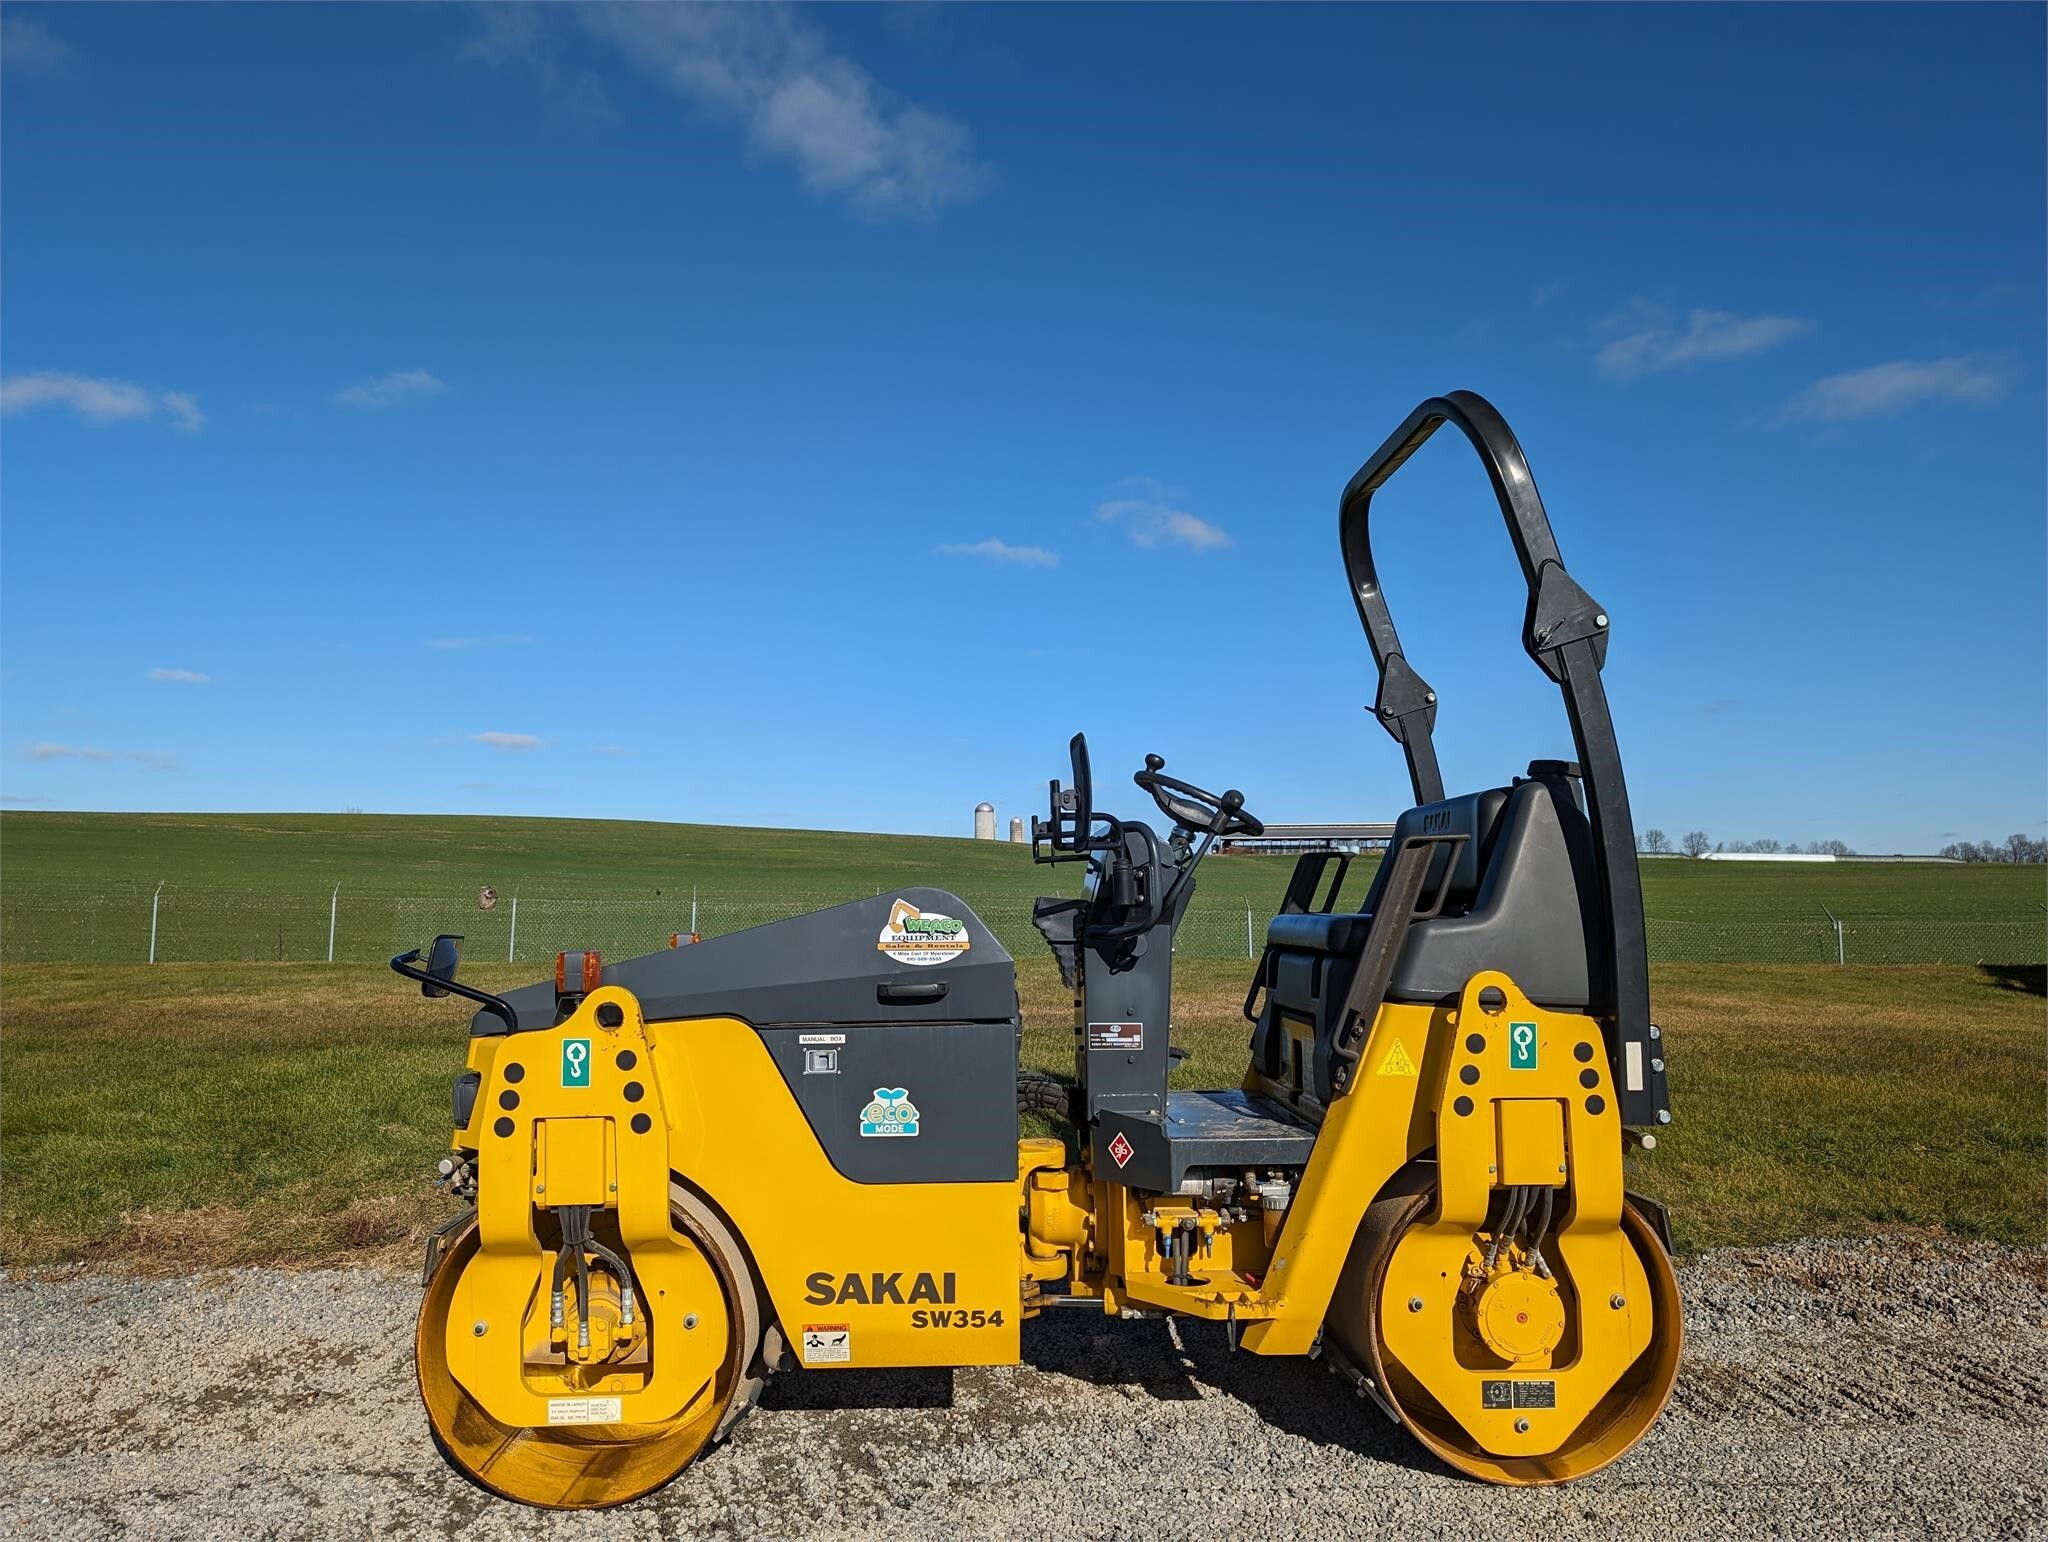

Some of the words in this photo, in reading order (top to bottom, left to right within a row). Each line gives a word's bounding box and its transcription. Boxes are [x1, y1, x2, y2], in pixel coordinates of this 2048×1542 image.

[903, 916, 963, 935] WEACO
[891, 935, 956, 943] EQUIPMENT
[875, 1125, 904, 1133] MODE
[804, 1272, 956, 1306] SAKAI
[911, 1310, 1005, 1329] SW354
[816, 1324, 847, 1332] WARNING
